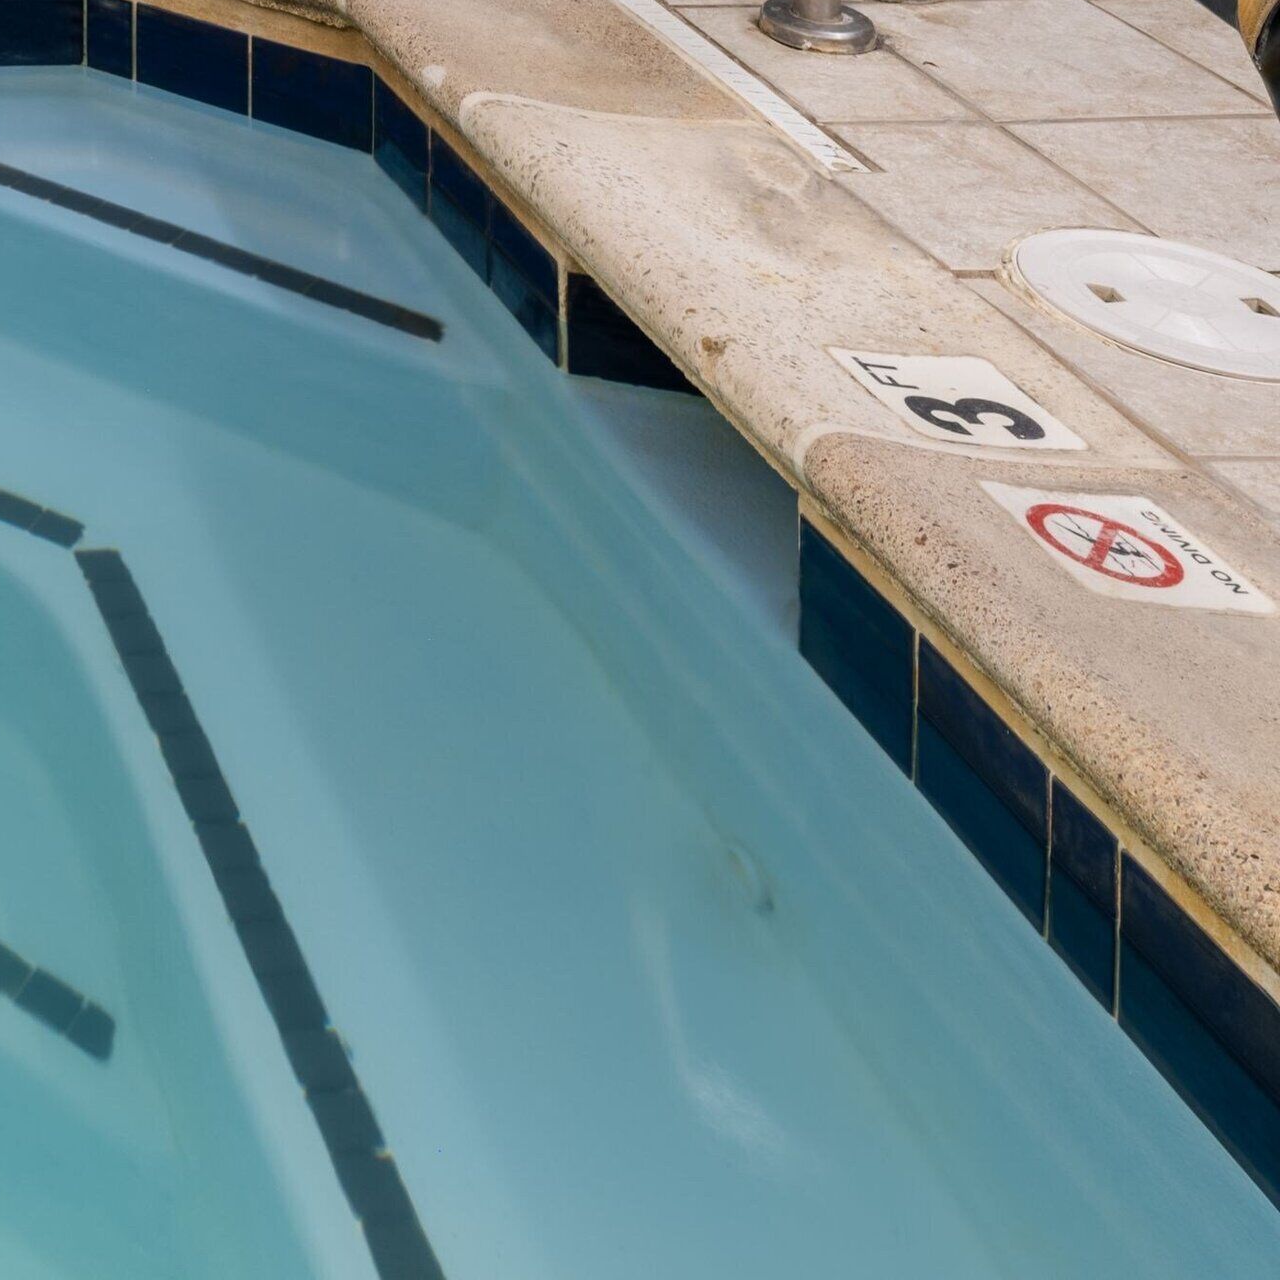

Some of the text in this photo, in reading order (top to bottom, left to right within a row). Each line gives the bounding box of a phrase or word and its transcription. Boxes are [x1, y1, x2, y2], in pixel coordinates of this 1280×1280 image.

[851, 355, 1046, 440] 3 FT
[1140, 510, 1249, 595] NO DIVING
